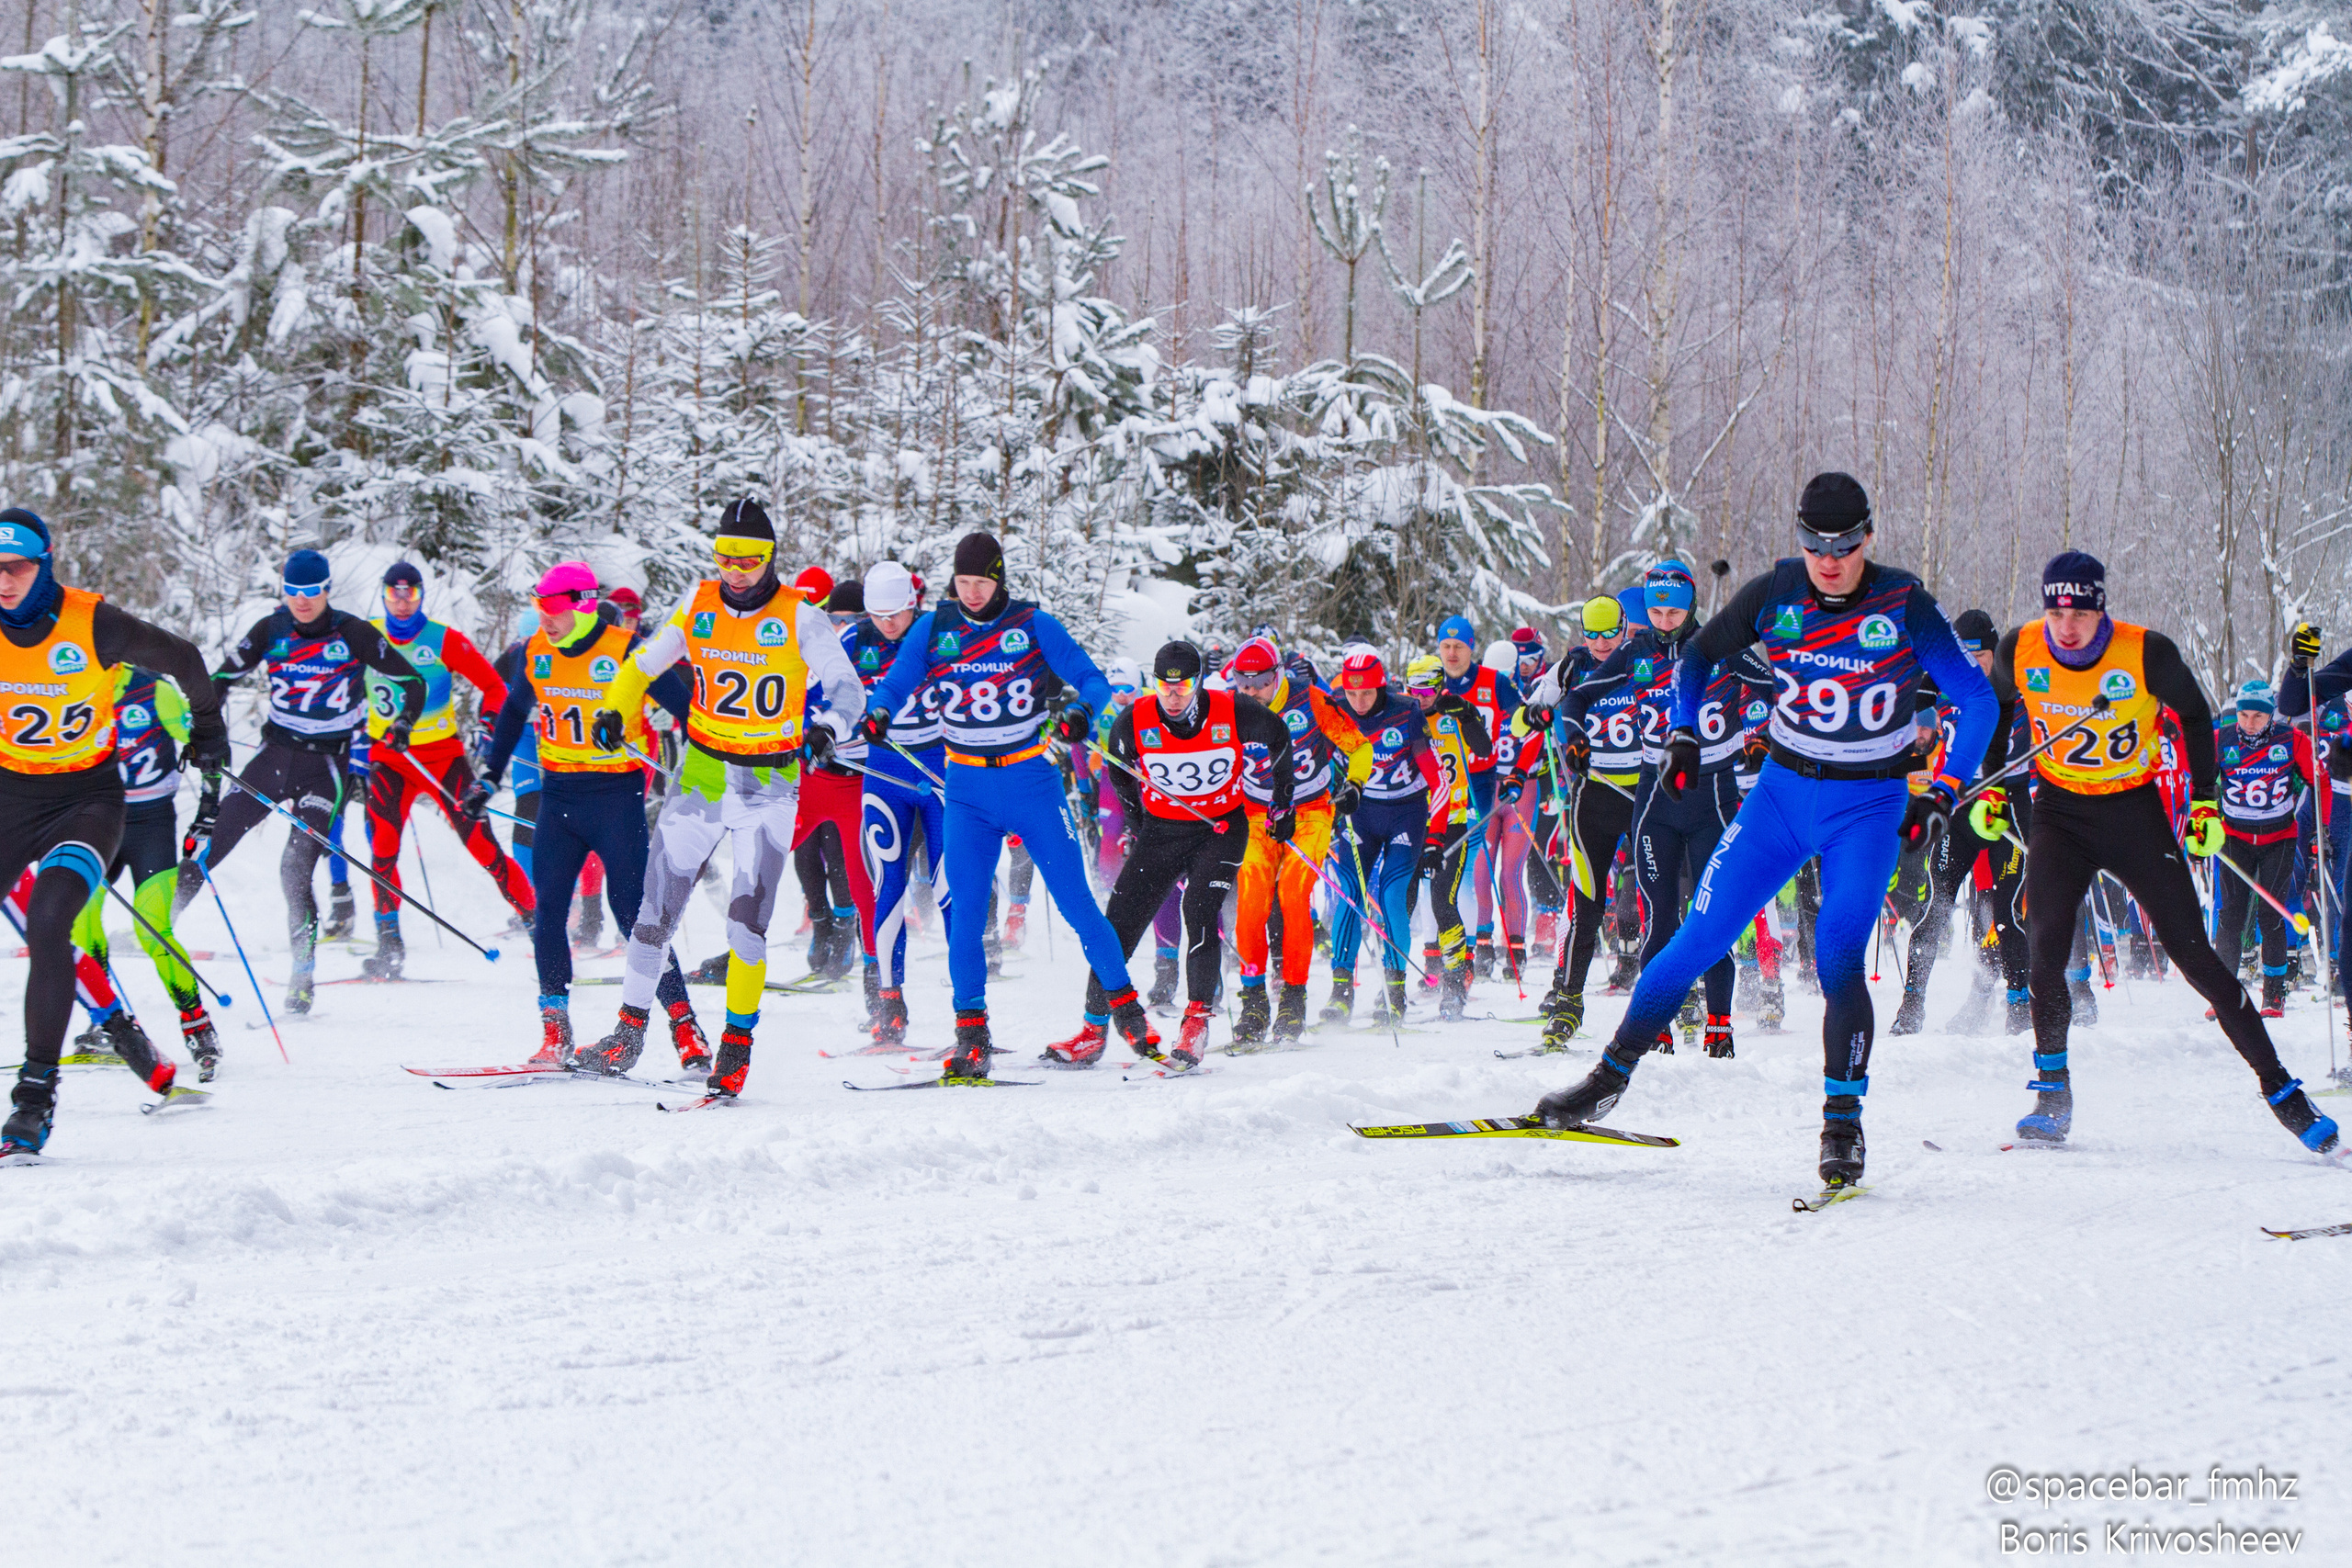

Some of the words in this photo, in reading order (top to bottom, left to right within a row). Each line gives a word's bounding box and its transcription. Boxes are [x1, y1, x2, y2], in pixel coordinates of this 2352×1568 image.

[2043, 581, 2084, 597] VITAL
[280, 662, 335, 674] ТРОИЦК
[700, 648, 768, 666] ТРОИЦК
[950, 661, 1015, 674] ТРОИЦК
[1742, 653, 1766, 674] CRAFT
[1786, 649, 1875, 673] ТРОИЦК
[0, 682, 68, 698] РОИЦК
[271, 676, 351, 714] 274
[540, 686, 605, 701] ТРОИЦК
[692, 664, 787, 719] 120
[939, 678, 1036, 722] 288
[1592, 694, 1635, 707] ТРОИЦ
[1774, 667, 1898, 732] 290
[0, 693, 96, 748] 25
[540, 703, 612, 745] 11
[1640, 701, 1726, 742] 26
[2040, 700, 2118, 721] ТРОИЦК
[1585, 711, 1634, 748] 26
[2033, 716, 2140, 767] 128
[1148, 757, 1231, 793] 338
[1242, 748, 1316, 784] 23
[1365, 759, 1413, 791] 24
[2233, 766, 2279, 775] ТРОИЦК
[2225, 775, 2290, 807] 265
[1642, 835, 1657, 873] CRAFT
[1940, 834, 1951, 865] CRAFT
[2007, 843, 2023, 874] Vitarg
[1694, 821, 1743, 915] SPINE
[1362, 1124, 1428, 1136] FISCHER
